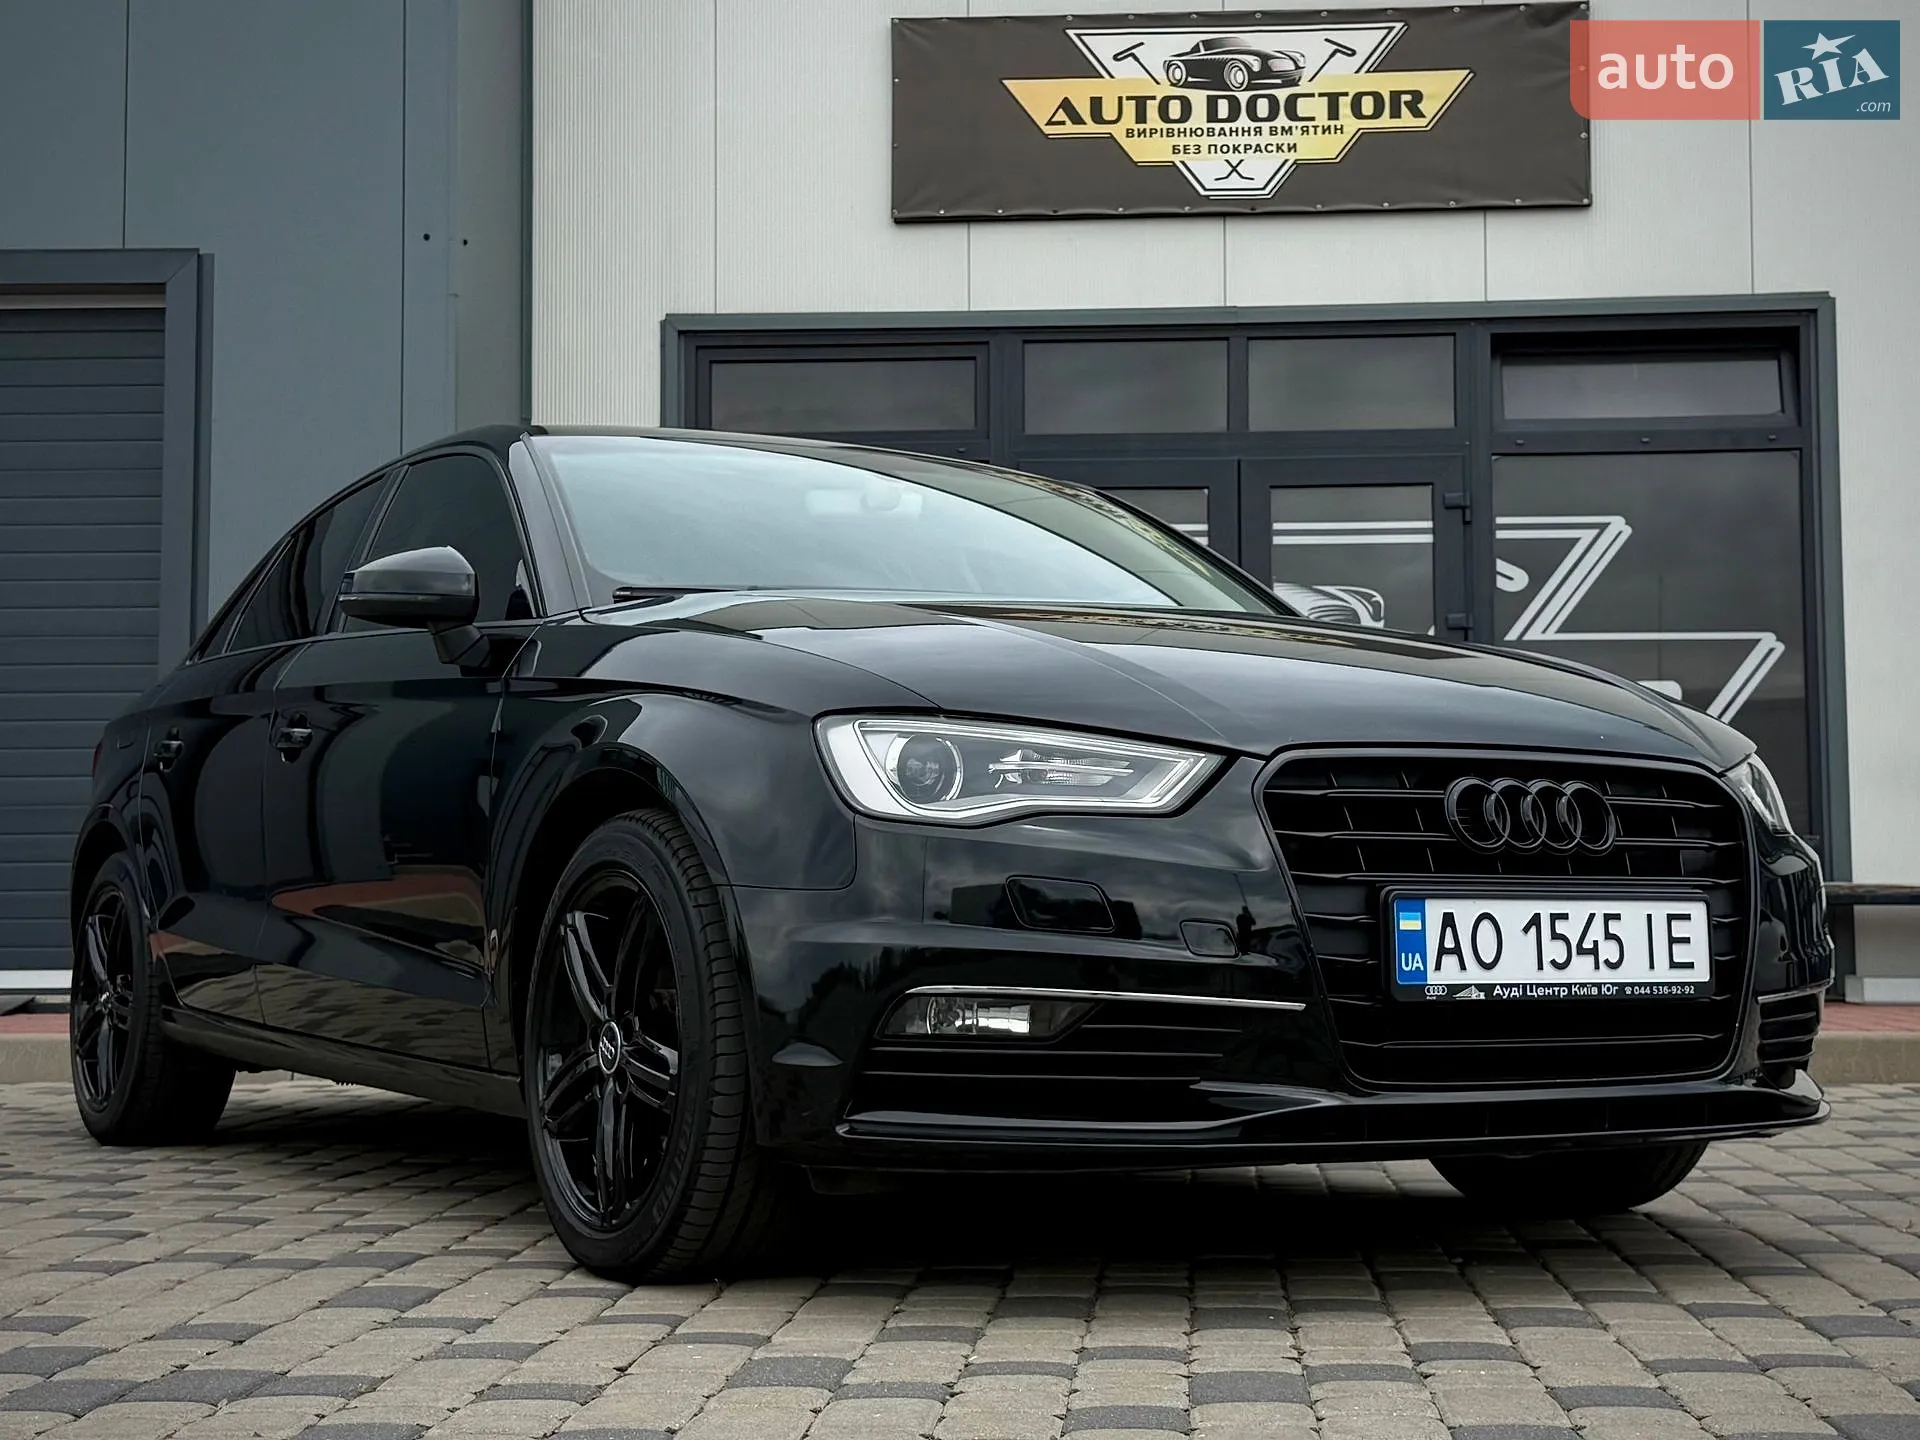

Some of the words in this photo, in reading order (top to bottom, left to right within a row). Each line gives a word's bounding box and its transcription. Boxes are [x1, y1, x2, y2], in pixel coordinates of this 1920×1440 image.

[1044, 95, 1193, 127] AUTO
[1206, 90, 1427, 124] DOCTOR
[1125, 127, 1263, 139] ВИРІВНЮВАННЯ
[1269, 124, 1344, 137] ВМ'ЯТИН
[1172, 144, 1202, 155] БЕЗ
[1208, 142, 1298, 155] ПОКРАСКИ
[1433, 911, 1503, 972] AO
[1521, 912, 1625, 971] 1545
[1646, 912, 1695, 971] IE
[1401, 952, 1424, 971] UA
[1493, 984, 1523, 999] Ауді
[1526, 984, 1568, 999] Центр
[1571, 984, 1598, 996] Київ
[1601, 984, 1619, 997] Юг
[1633, 985, 1651, 995] 044
[1652, 985, 1695, 995] 536-92-92
